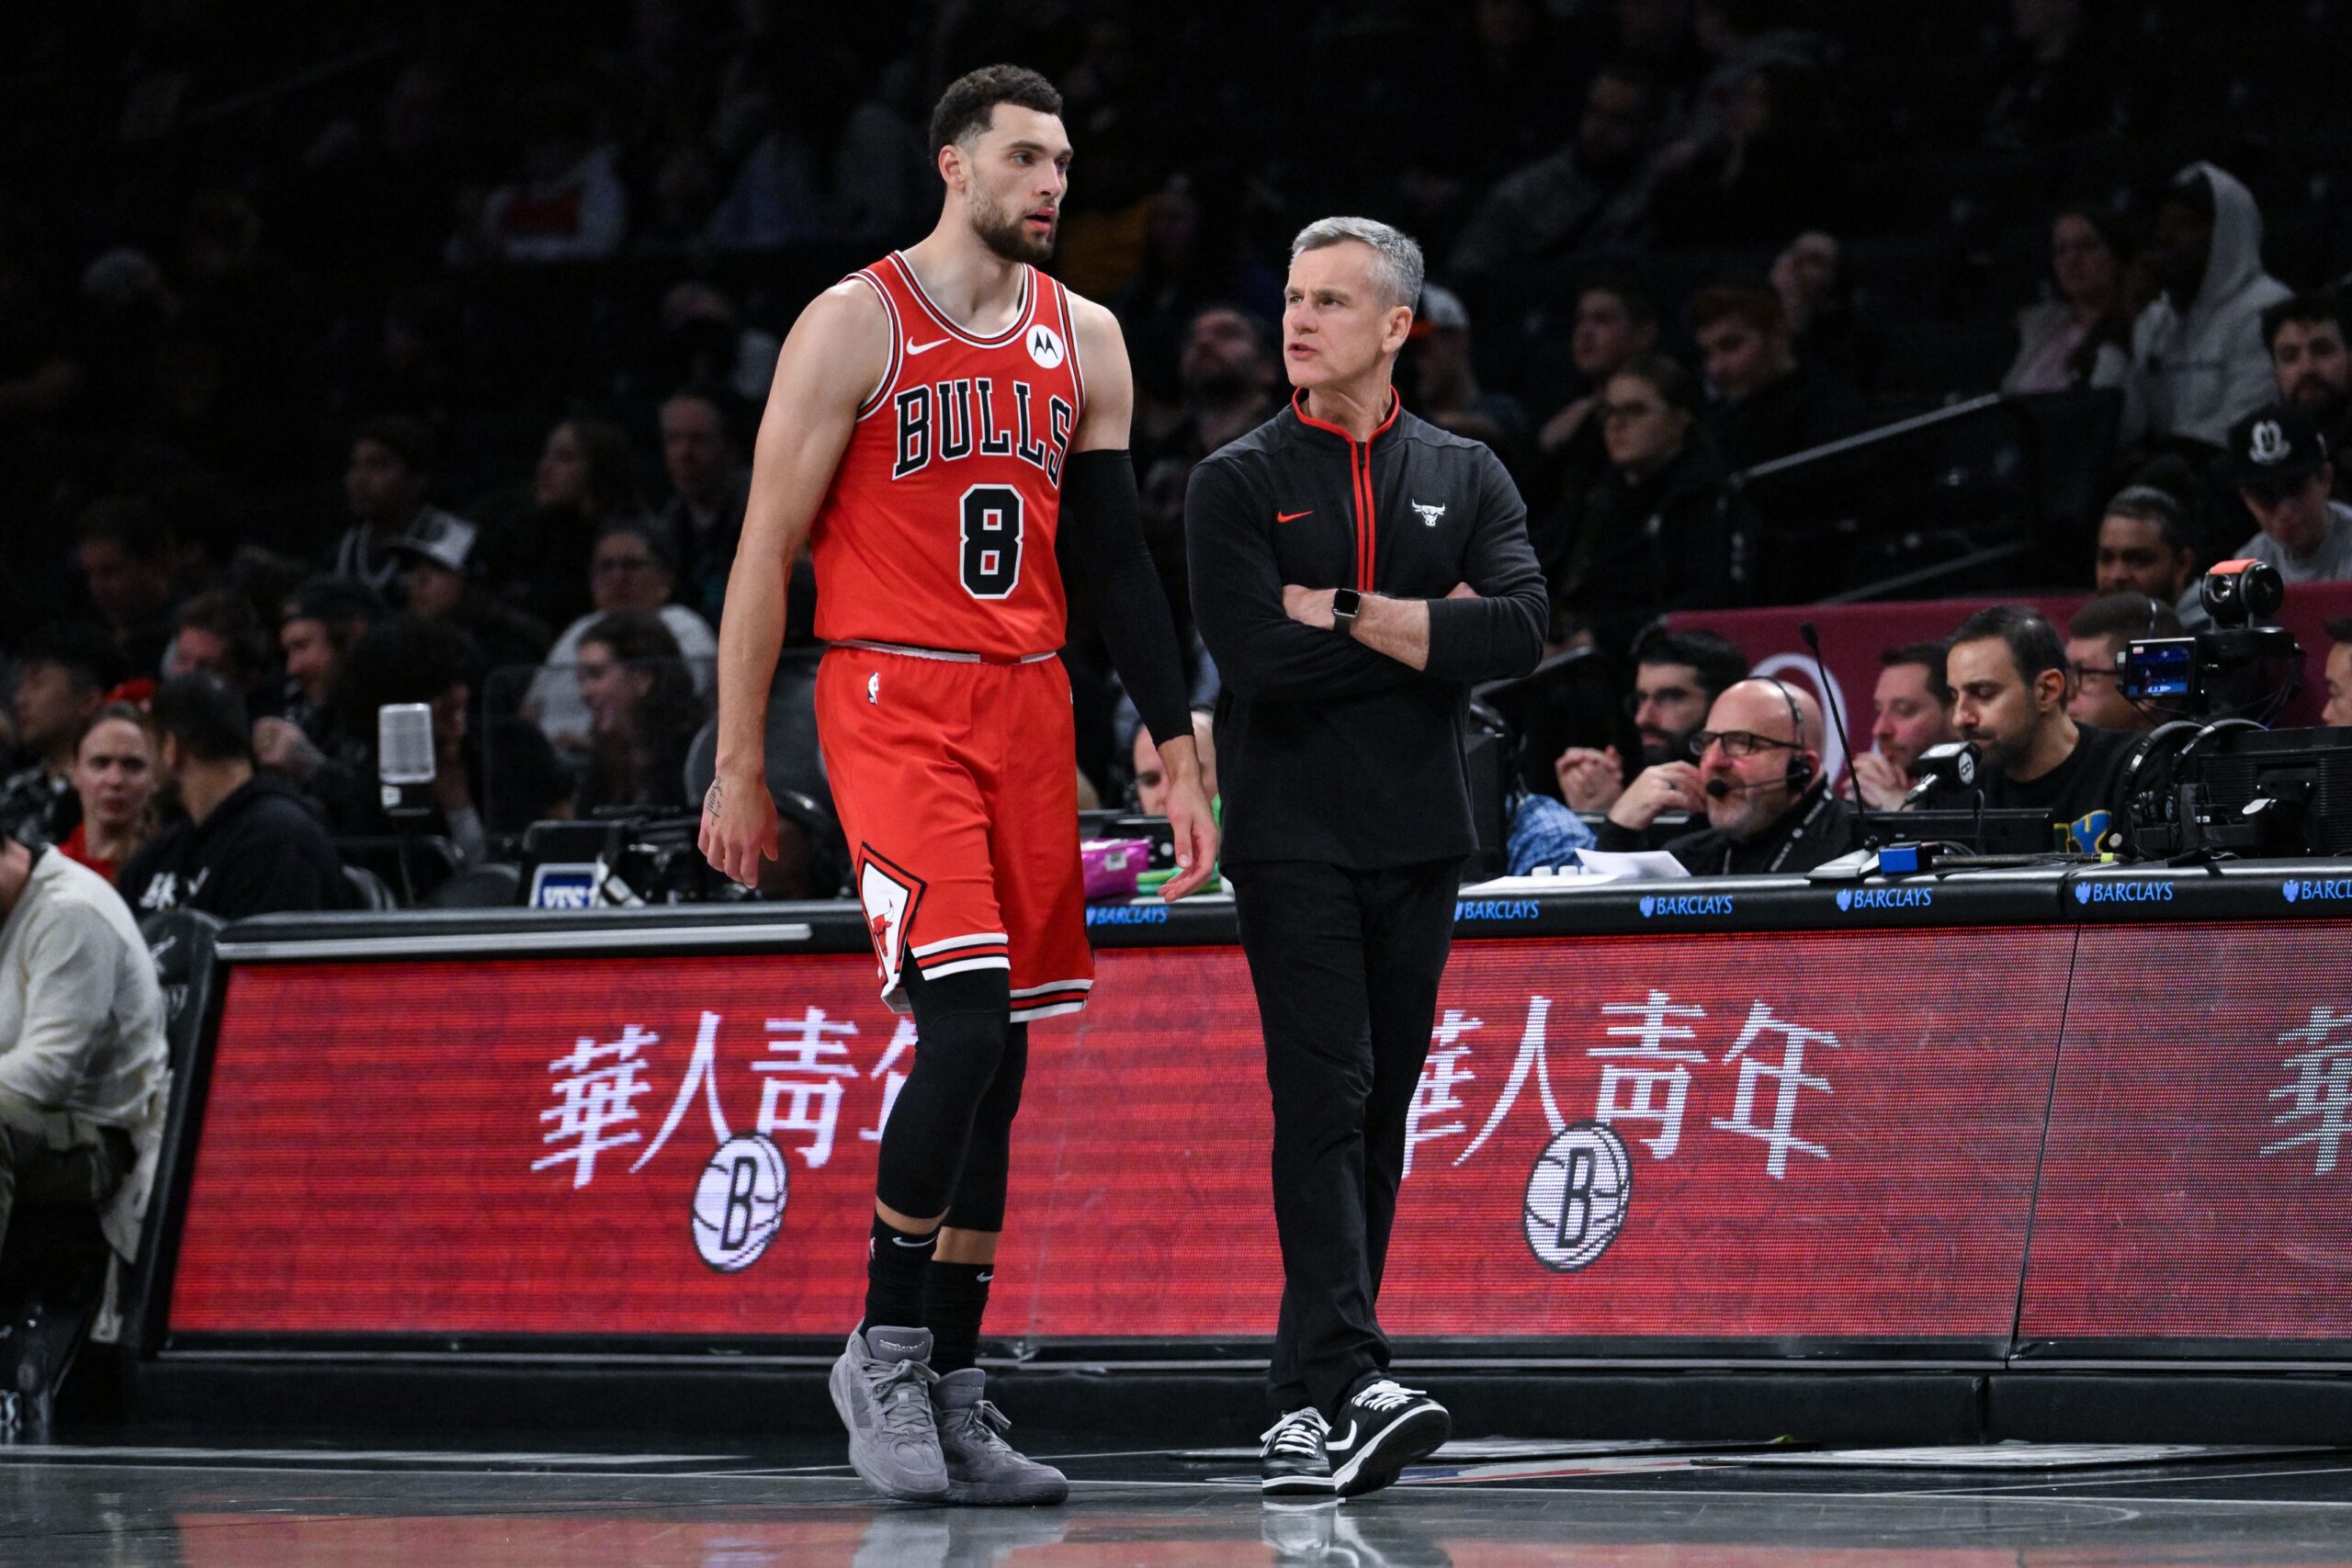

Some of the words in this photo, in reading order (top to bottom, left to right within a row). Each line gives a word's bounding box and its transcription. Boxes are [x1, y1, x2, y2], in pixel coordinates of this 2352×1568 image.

[892, 378, 1073, 490] BULLS
[959, 483, 1023, 600] 8
[1854, 887, 1932, 908] BARCLAYS
[2093, 882, 2174, 902] BARCLAYS
[1096, 906, 1168, 925] BARCLAYS
[1465, 899, 1541, 919] BARCLAYS
[1657, 895, 1734, 916] BARCLAYS
[720, 1156, 757, 1251] B
[1556, 1147, 1597, 1248] B
